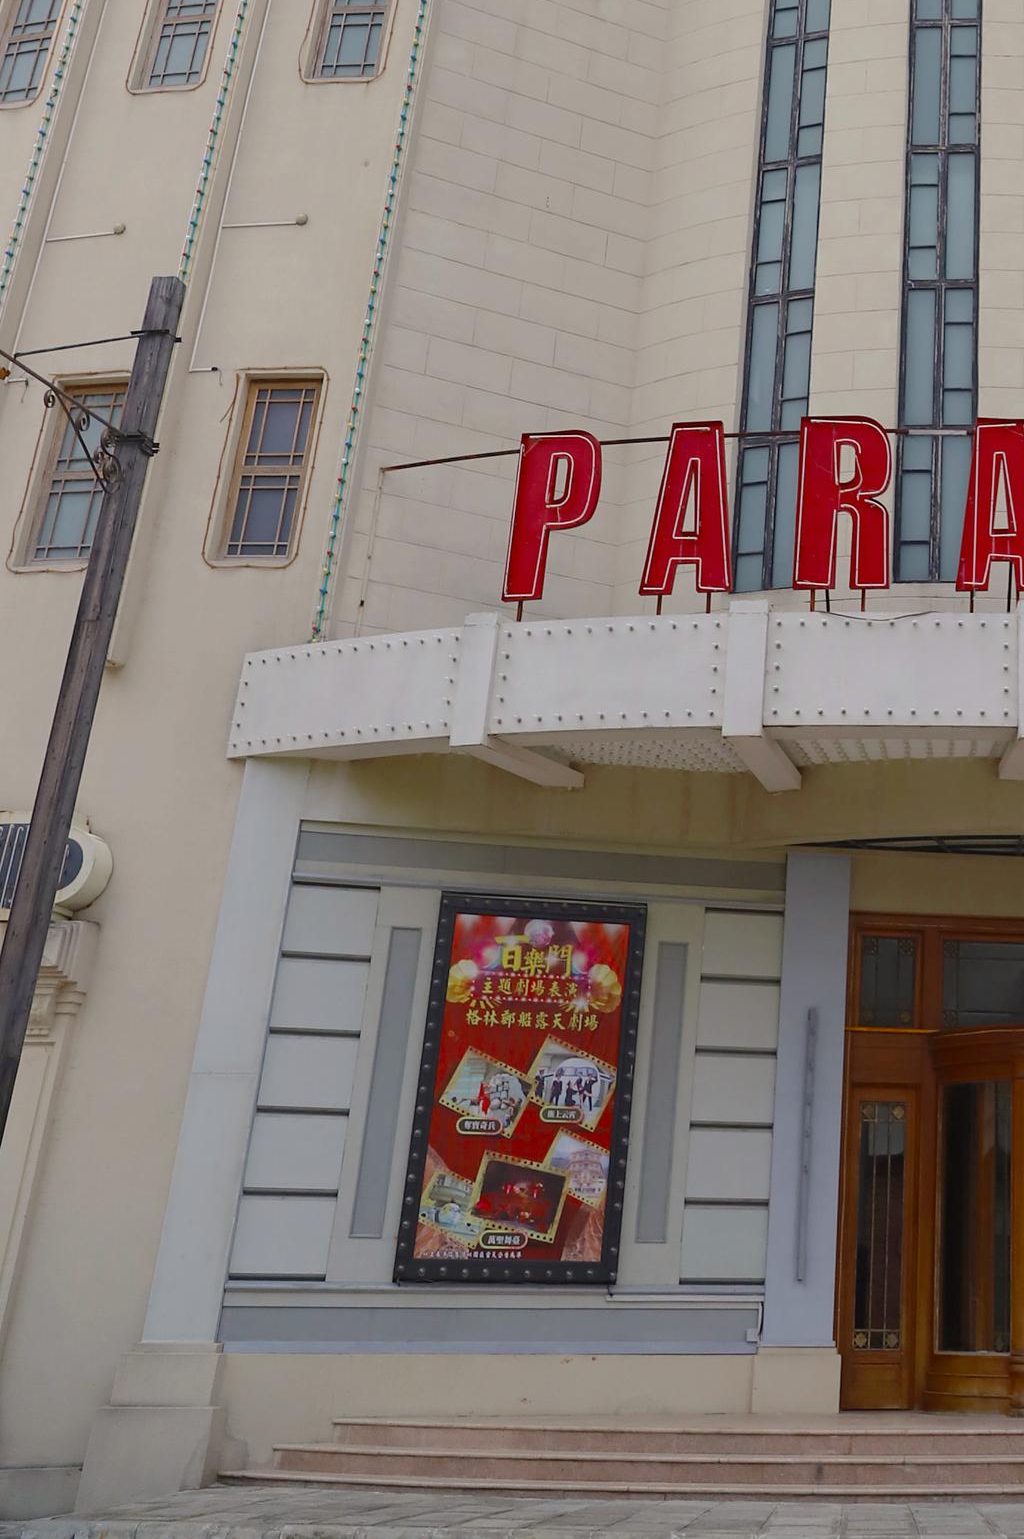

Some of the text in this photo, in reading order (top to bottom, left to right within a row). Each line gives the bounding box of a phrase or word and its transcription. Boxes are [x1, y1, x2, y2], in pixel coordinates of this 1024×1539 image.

[495, 935, 574, 977] 百樂門
[482, 977, 579, 997] 主題劇場表演
